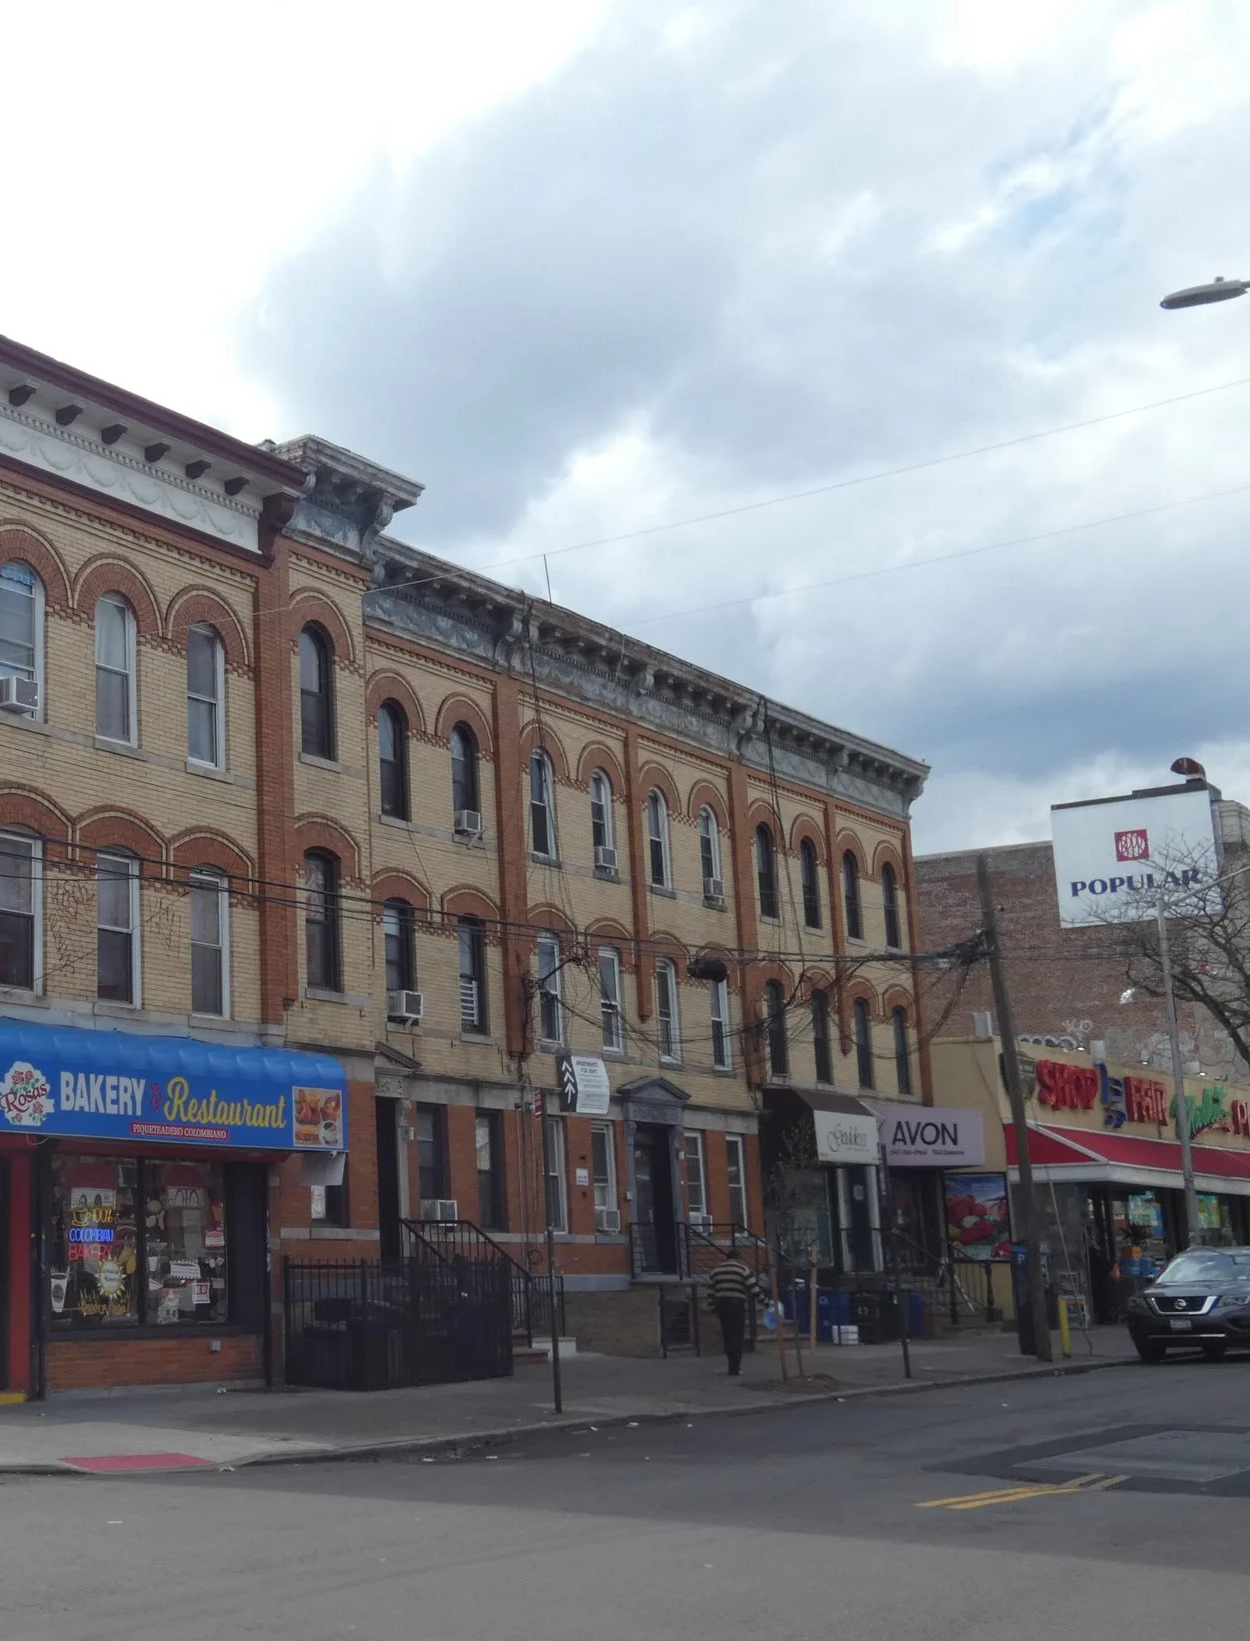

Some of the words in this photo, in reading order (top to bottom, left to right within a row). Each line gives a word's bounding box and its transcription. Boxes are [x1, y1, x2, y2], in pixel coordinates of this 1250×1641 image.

[1071, 868, 1203, 898] POPULAR
[0, 1083, 49, 1114] Rosas
[60, 1071, 147, 1117] BAKERY
[163, 1076, 287, 1129] Restaurant
[133, 1123, 184, 1137] PIQUETEADERO
[183, 1126, 227, 1140] COLOMBIANO
[892, 1121, 959, 1146] AVON
[69, 1228, 114, 1242] COLOMBIAN
[69, 1244, 113, 1261] BAKERY
